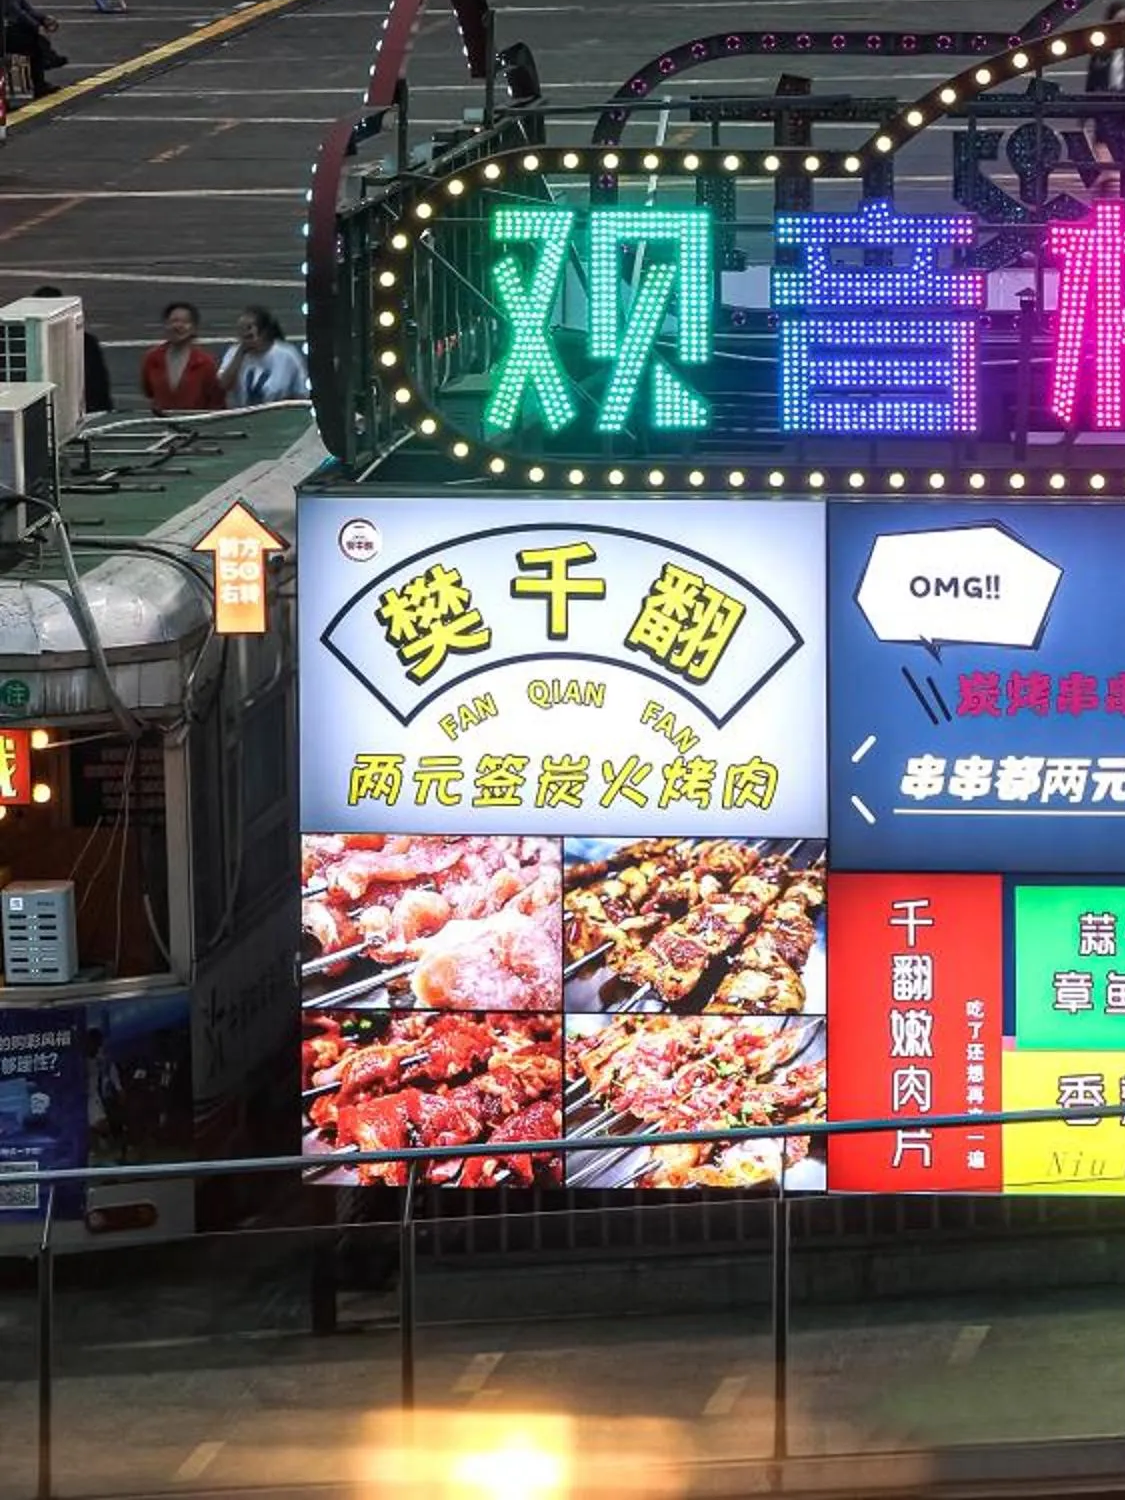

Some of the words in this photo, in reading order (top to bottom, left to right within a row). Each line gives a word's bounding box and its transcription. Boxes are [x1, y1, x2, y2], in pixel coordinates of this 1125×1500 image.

[373, 540, 747, 687] 樊千翻
[908, 574, 1001, 600] OMG!!
[437, 691, 499, 742] FAN
[527, 678, 606, 709] QIAN
[639, 699, 701, 755] FAN
[346, 753, 780, 810] 两元签炭火烤肉
[888, 897, 936, 1171] 千翻嫩肉片
[1046, 1150, 1107, 1178] Niu
